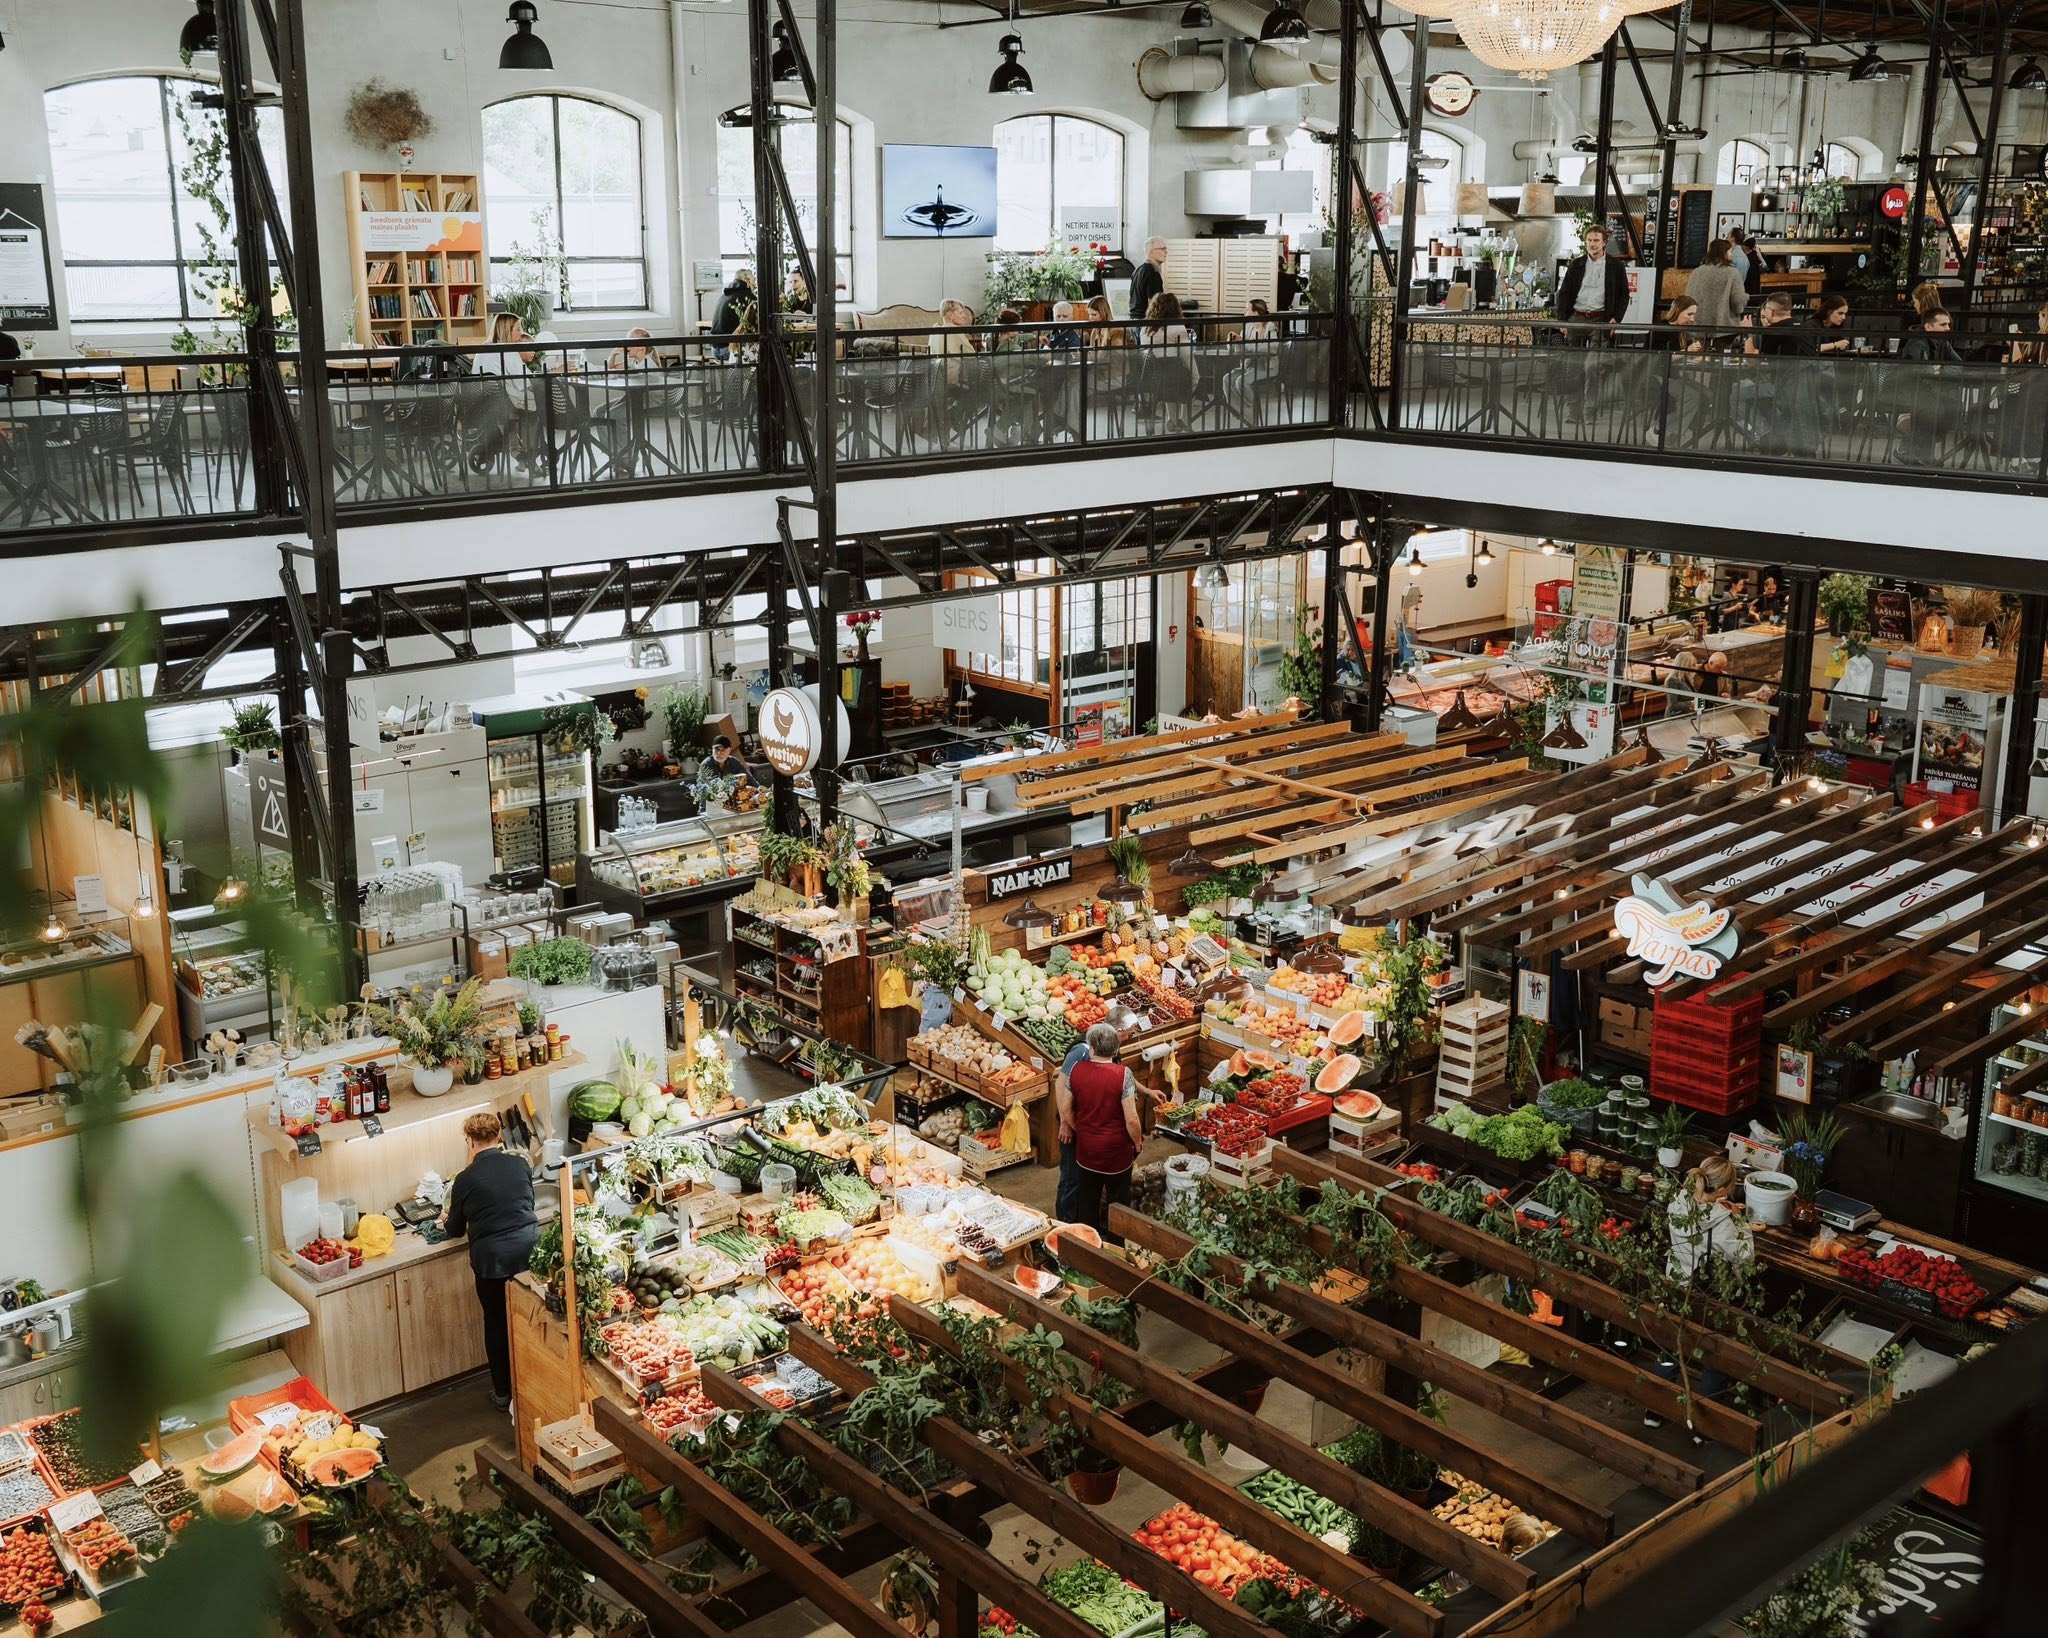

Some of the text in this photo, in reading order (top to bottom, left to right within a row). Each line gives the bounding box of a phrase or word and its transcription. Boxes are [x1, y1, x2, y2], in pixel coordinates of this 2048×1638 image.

[370, 216, 432, 225] Swedbank grāmatu
[1091, 221, 1115, 229] TRAUKI
[370, 223, 418, 232] maiņas plaukts
[943, 606, 988, 631] SIERS
[1877, 631, 1905, 641] STEIKS
[991, 861, 1071, 897] ŅAM-ŅAM
